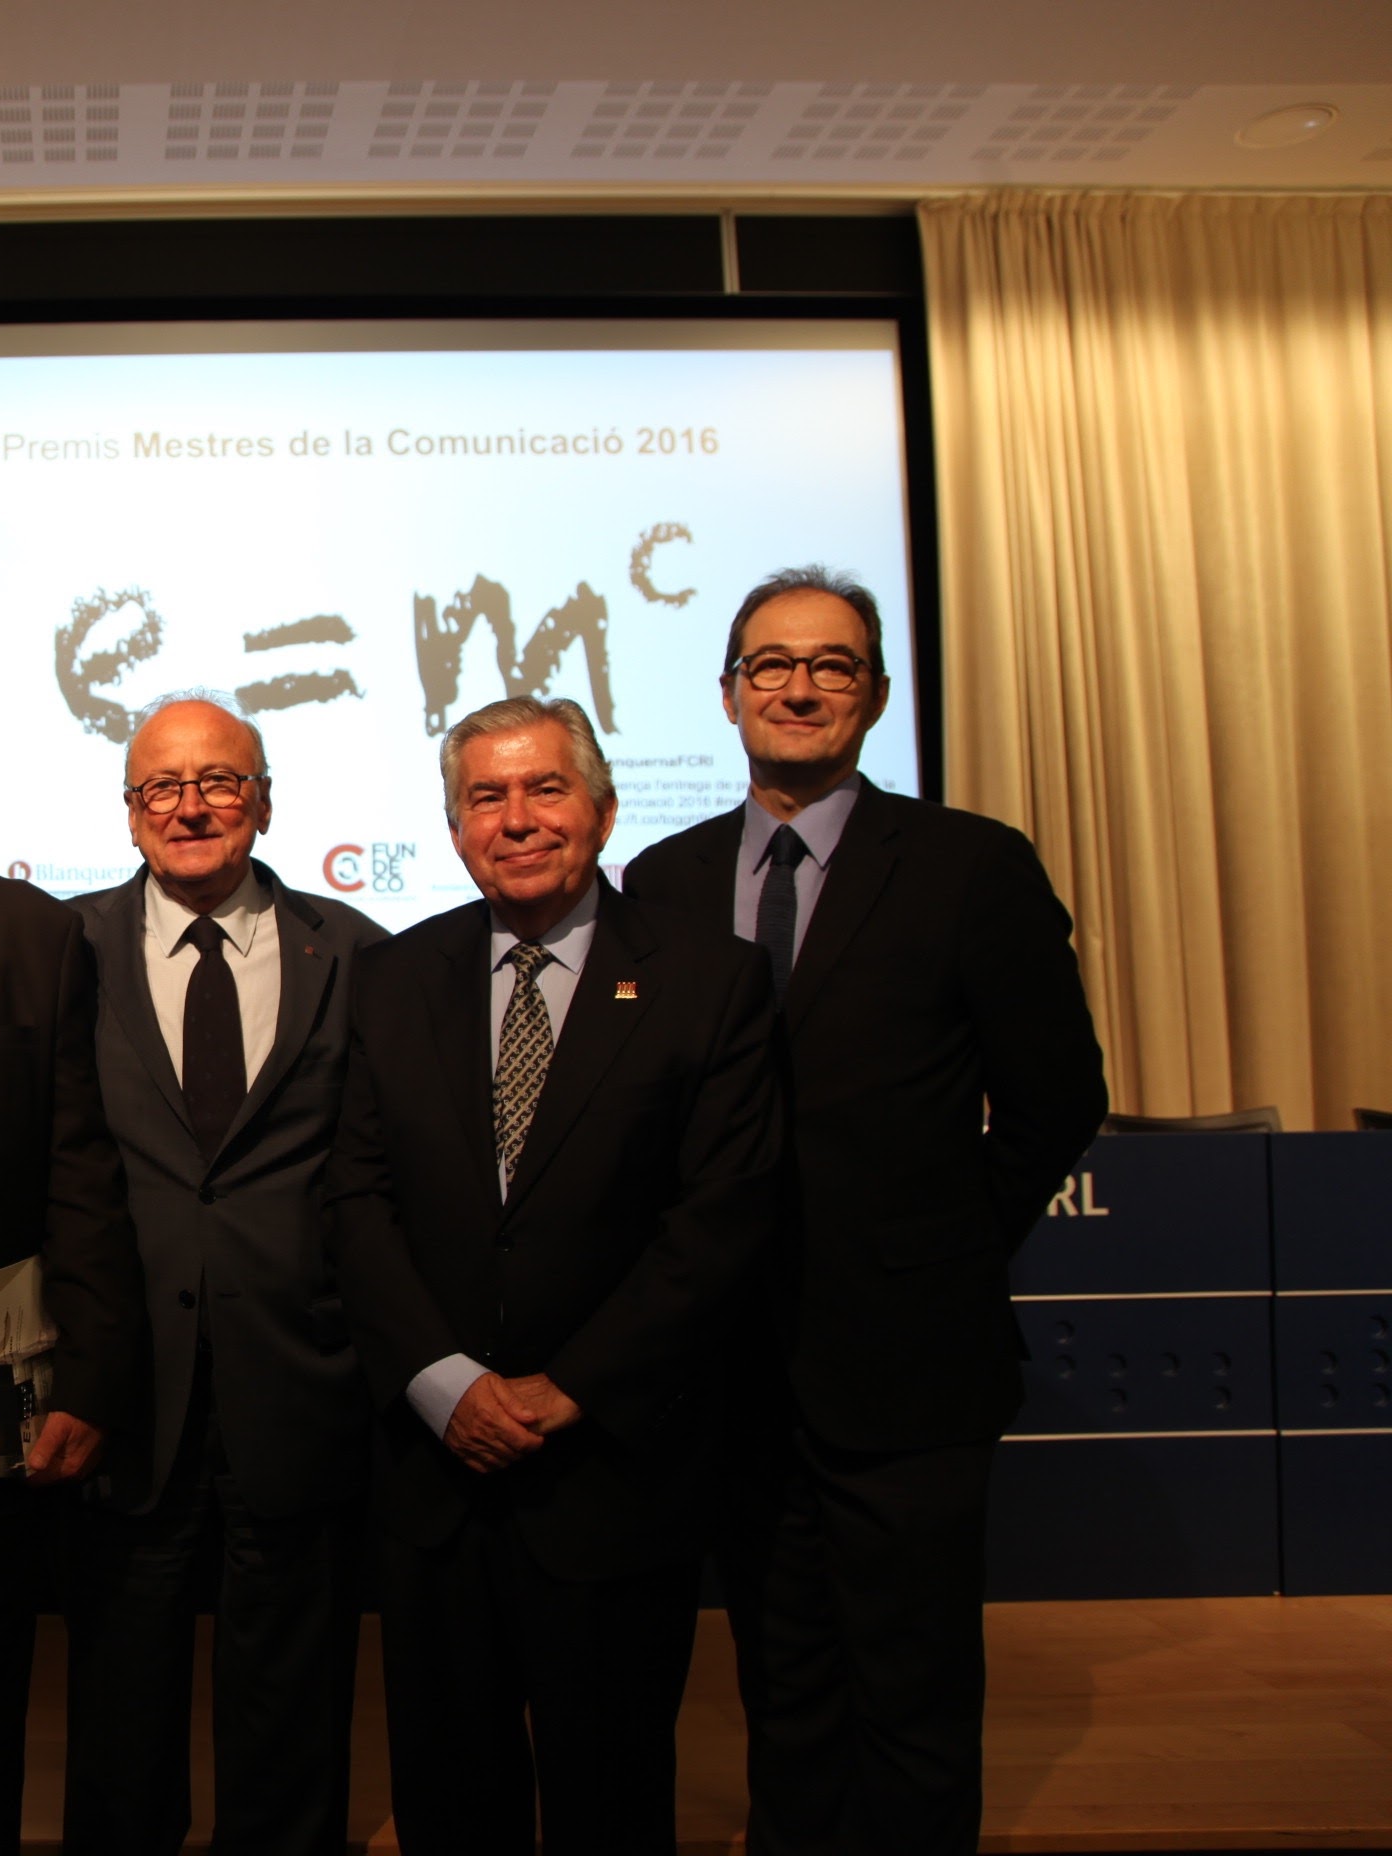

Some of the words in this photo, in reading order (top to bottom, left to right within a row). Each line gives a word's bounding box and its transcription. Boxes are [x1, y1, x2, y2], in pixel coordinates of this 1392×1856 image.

[2, 432, 120, 461] Premis
[133, 431, 274, 458] Mestres
[288, 429, 331, 457] de
[344, 429, 373, 456] la
[387, 427, 623, 456] Comunicació
[637, 426, 718, 455] 2016
[371, 842, 416, 859] FUN
[35, 863, 137, 885] Blanquern
[371, 859, 401, 876] DE
[371, 876, 405, 893] CO
[1046, 1171, 1110, 1217] RL
